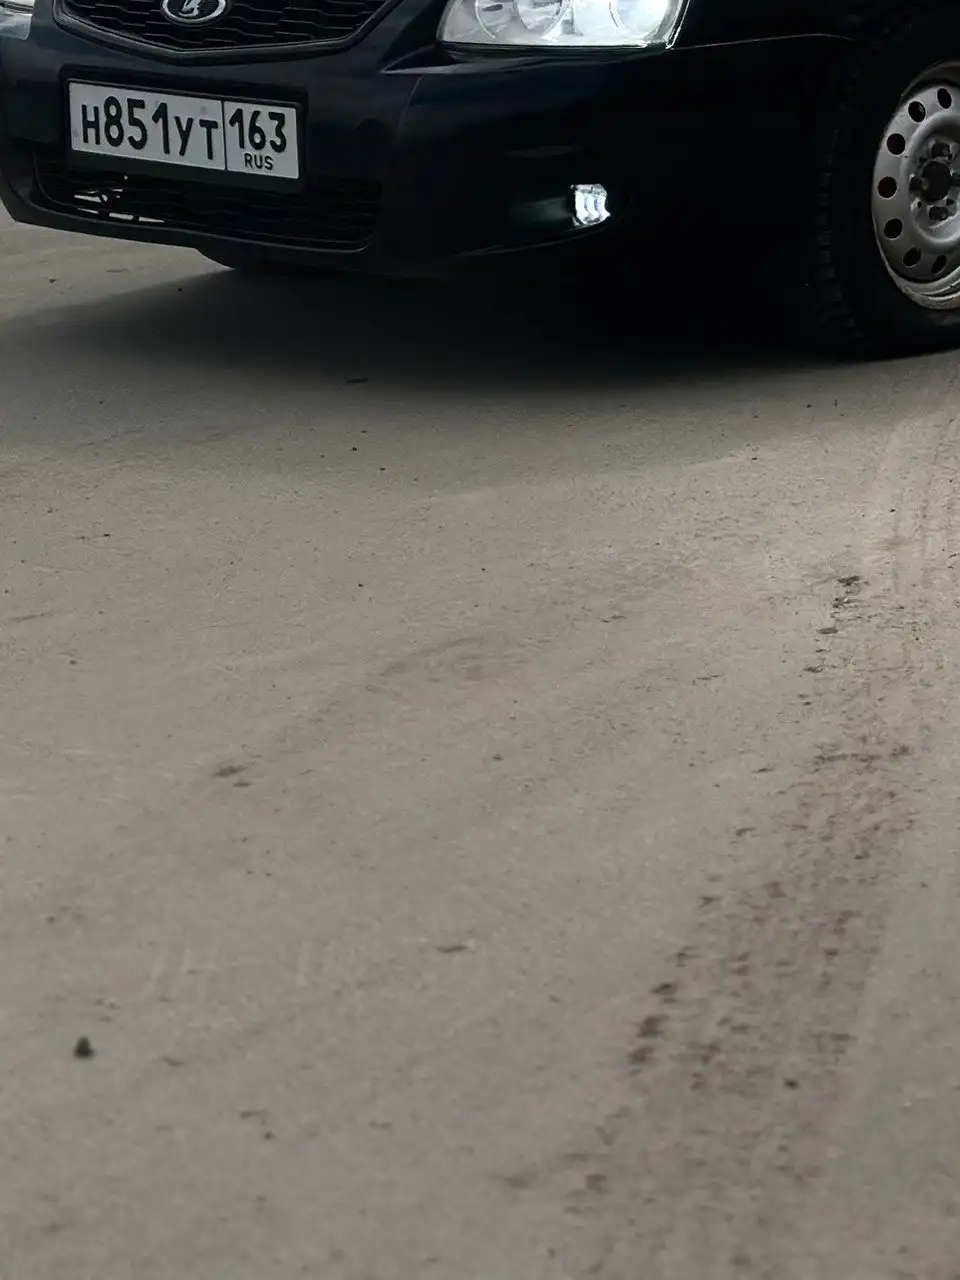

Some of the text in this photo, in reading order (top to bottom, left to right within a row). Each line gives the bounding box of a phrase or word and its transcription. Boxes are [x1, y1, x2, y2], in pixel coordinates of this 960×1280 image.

[81, 95, 287, 160] Н851УТ 163
[244, 152, 273, 171] RUS
